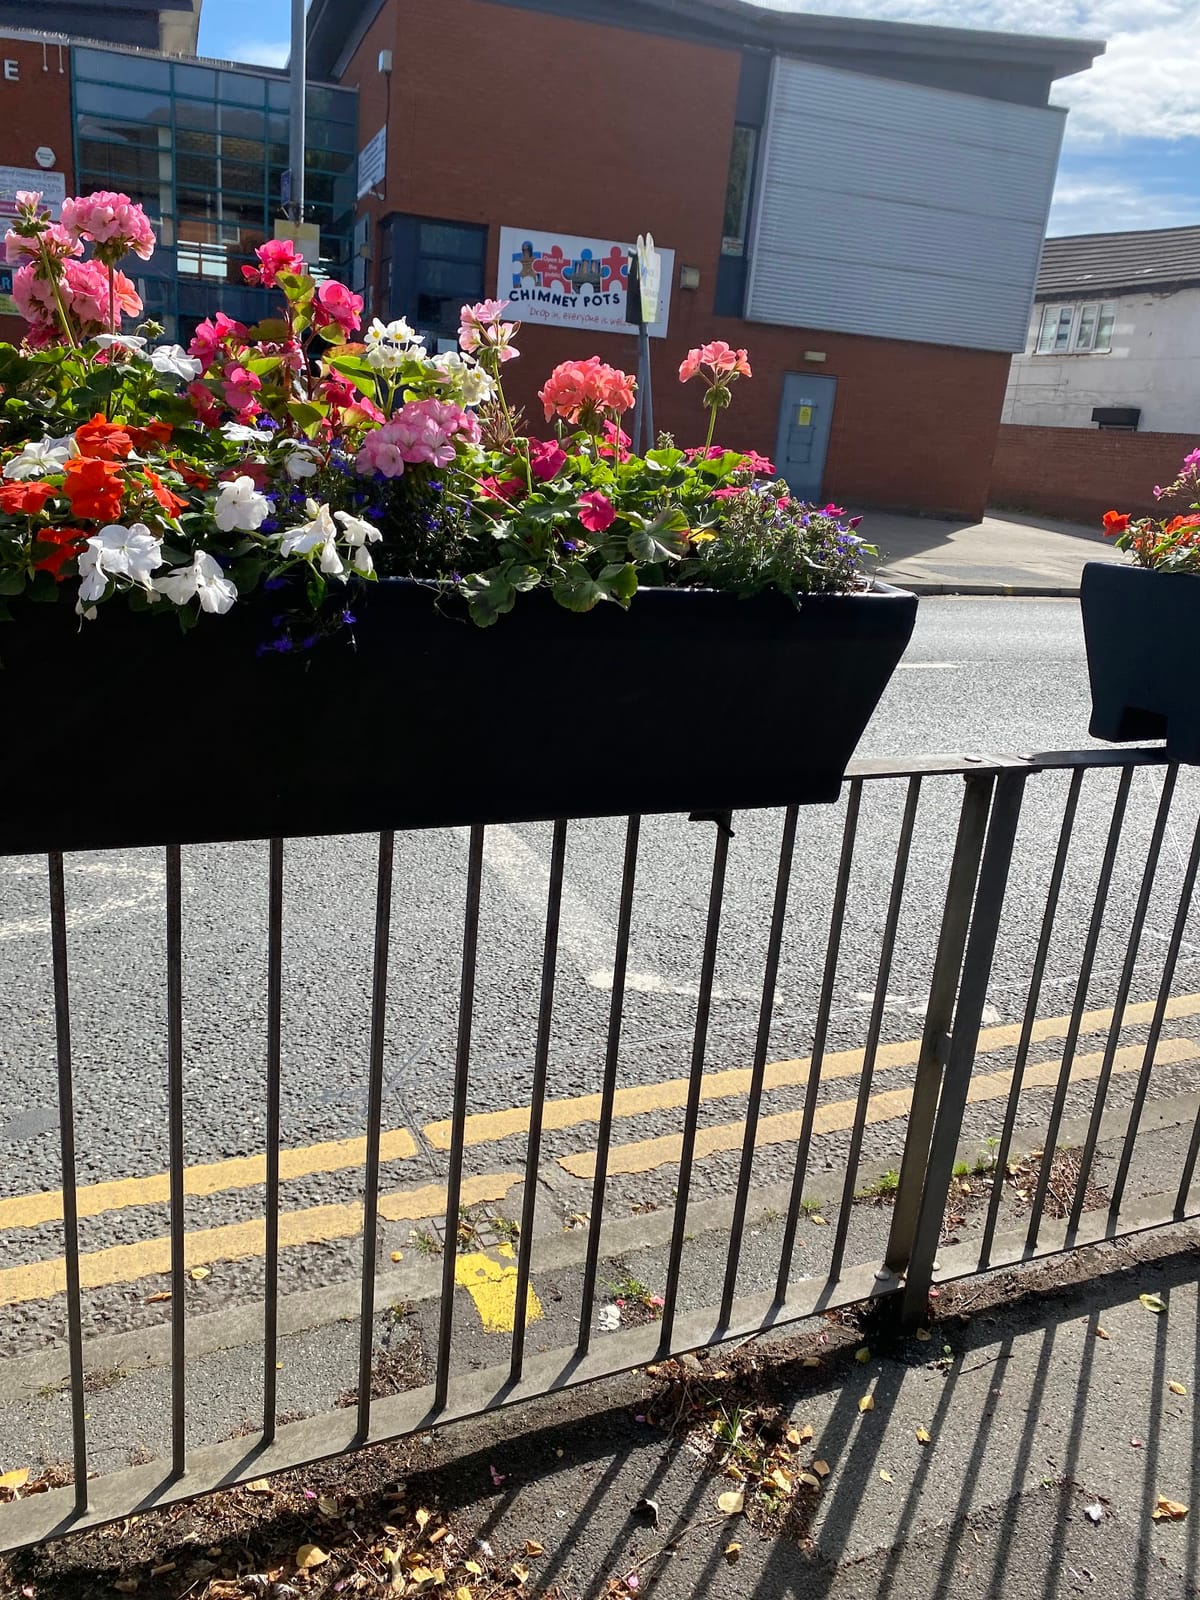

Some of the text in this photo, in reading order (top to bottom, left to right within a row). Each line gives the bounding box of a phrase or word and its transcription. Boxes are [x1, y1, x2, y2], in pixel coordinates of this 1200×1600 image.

[4, 59, 20, 81] E
[509, 290, 620, 307] CHIMNEY POTS
[530, 307, 550, 320] Drop
